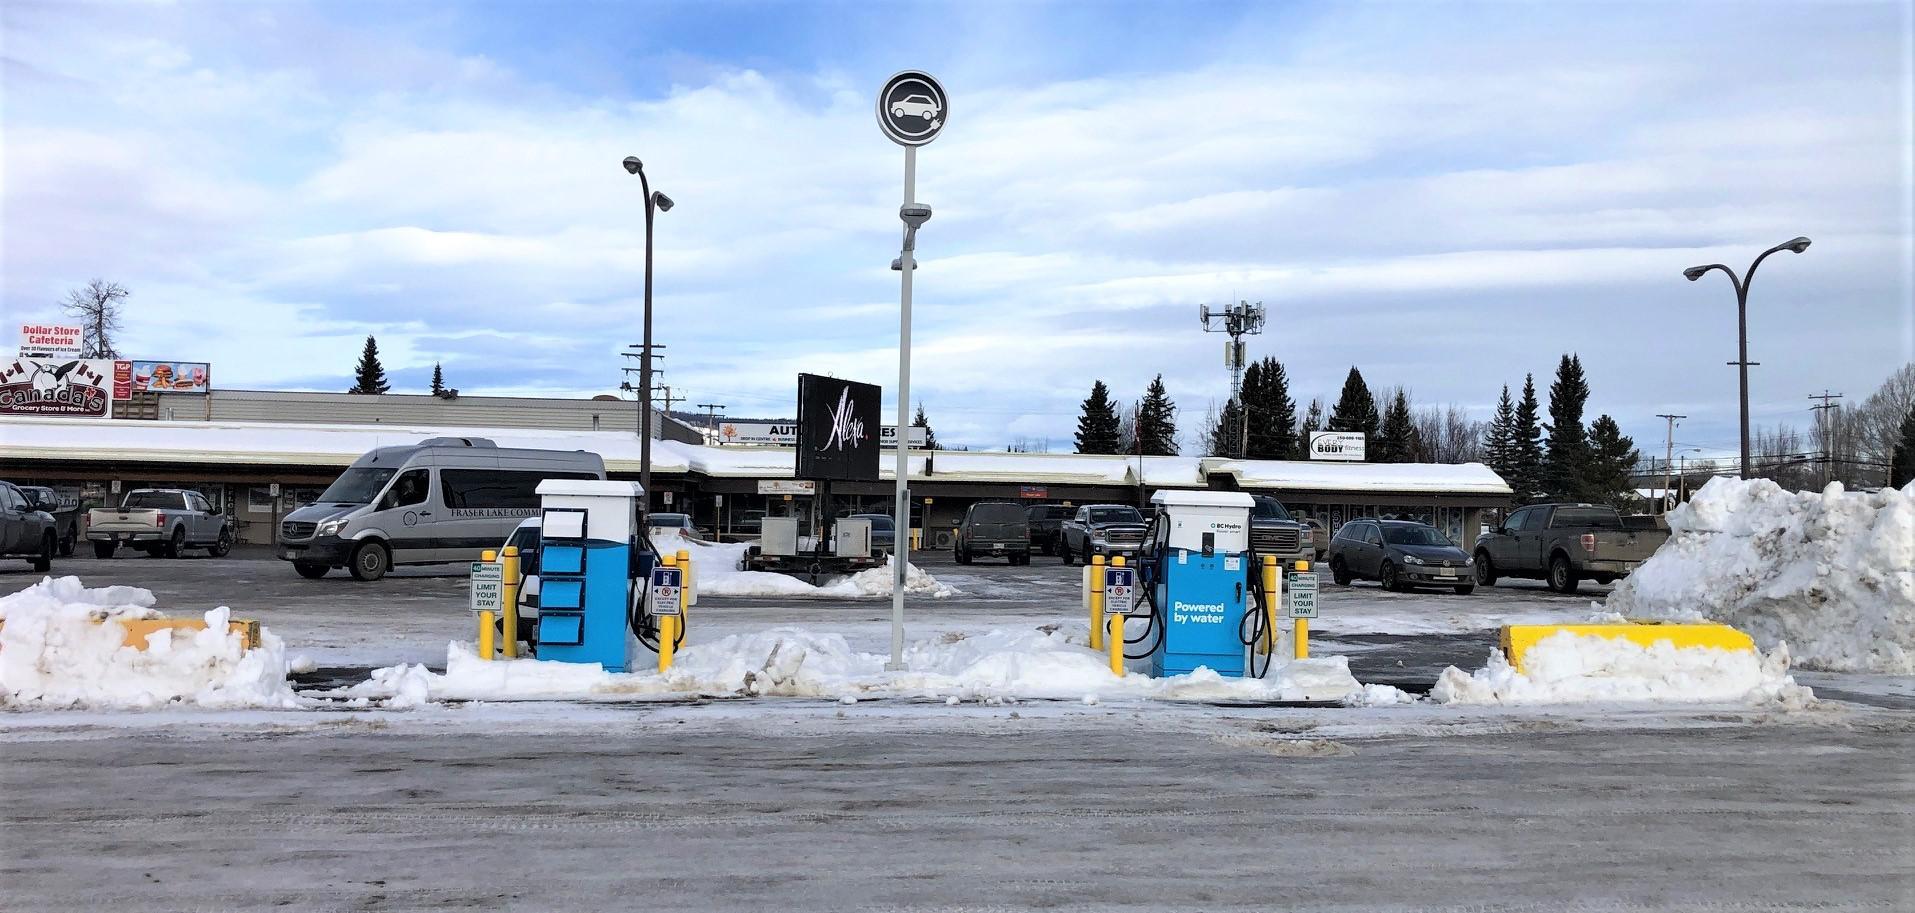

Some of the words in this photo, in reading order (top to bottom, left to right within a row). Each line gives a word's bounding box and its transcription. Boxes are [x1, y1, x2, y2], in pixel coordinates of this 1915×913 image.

[23, 326, 52, 334] Dollar
[54, 327, 80, 335] Store
[29, 336, 73, 345] Cafeteria
[12, 404, 40, 412] Grocery
[769, 425, 797, 435] AUT
[880, 428, 896, 437] ES
[1317, 445, 1343, 453] BODY
[451, 508, 484, 517] FRASER
[486, 508, 509, 517] LAKE
[1174, 601, 1224, 612] Powered
[1174, 612, 1188, 624] by
[1190, 614, 1224, 623] water
